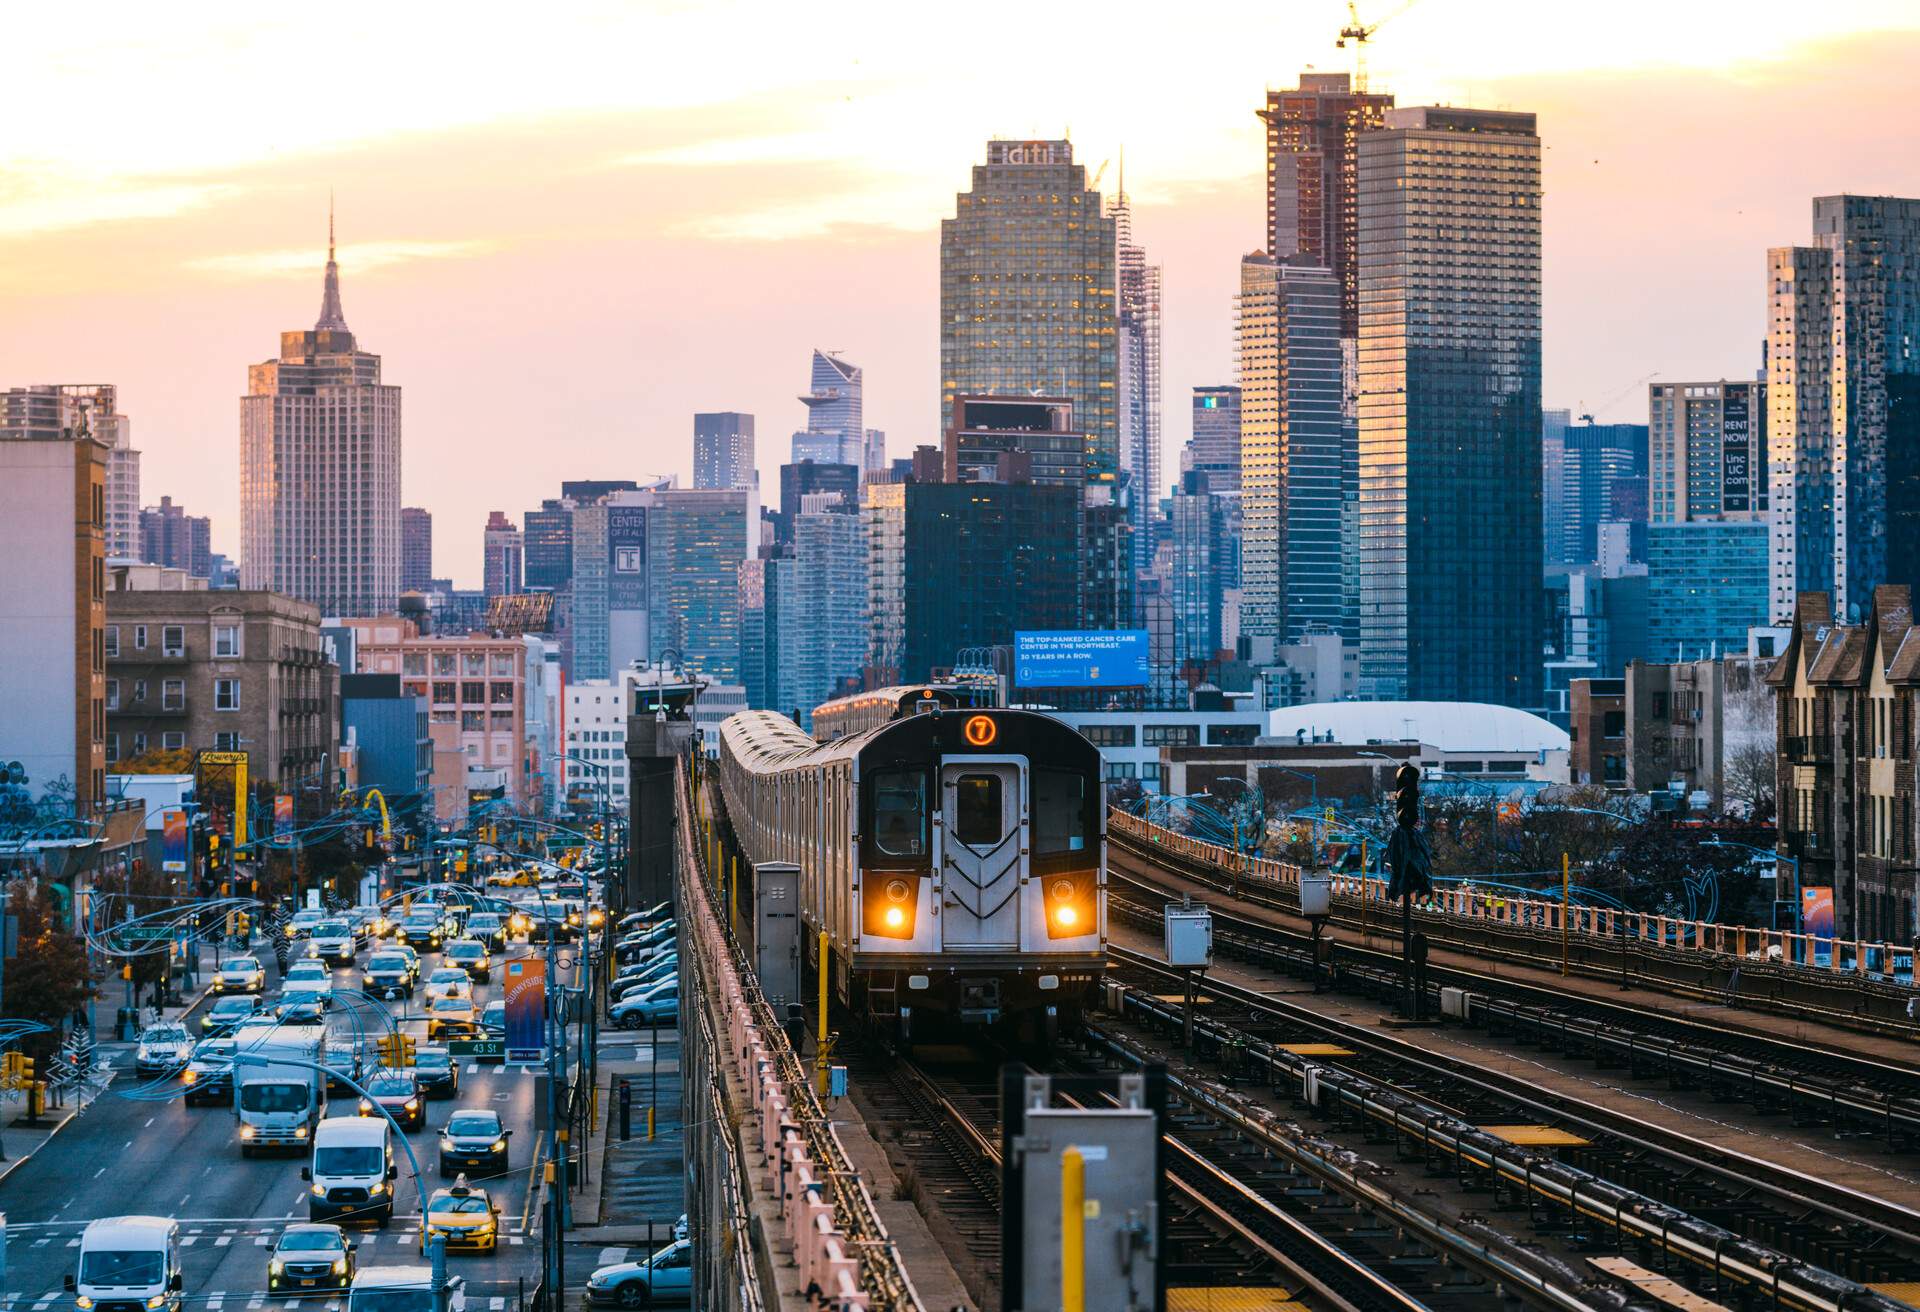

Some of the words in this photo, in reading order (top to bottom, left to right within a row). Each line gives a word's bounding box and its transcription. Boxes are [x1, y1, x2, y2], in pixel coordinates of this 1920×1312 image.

[1009, 144, 1048, 165] citi
[1724, 420, 1747, 430] RENT
[1724, 433, 1748, 442] NOW
[1726, 454, 1746, 463] Linc
[1728, 465, 1744, 475] LIC
[611, 516, 644, 527] CENTER
[611, 529, 622, 537] OF
[631, 529, 644, 537] ALL
[1073, 652, 1093, 660] ROW.
[975, 721, 987, 740] 7
[505, 975, 544, 1005] SUNNYSIDE
[473, 1044, 482, 1053] 43
[487, 1043, 497, 1053] St
